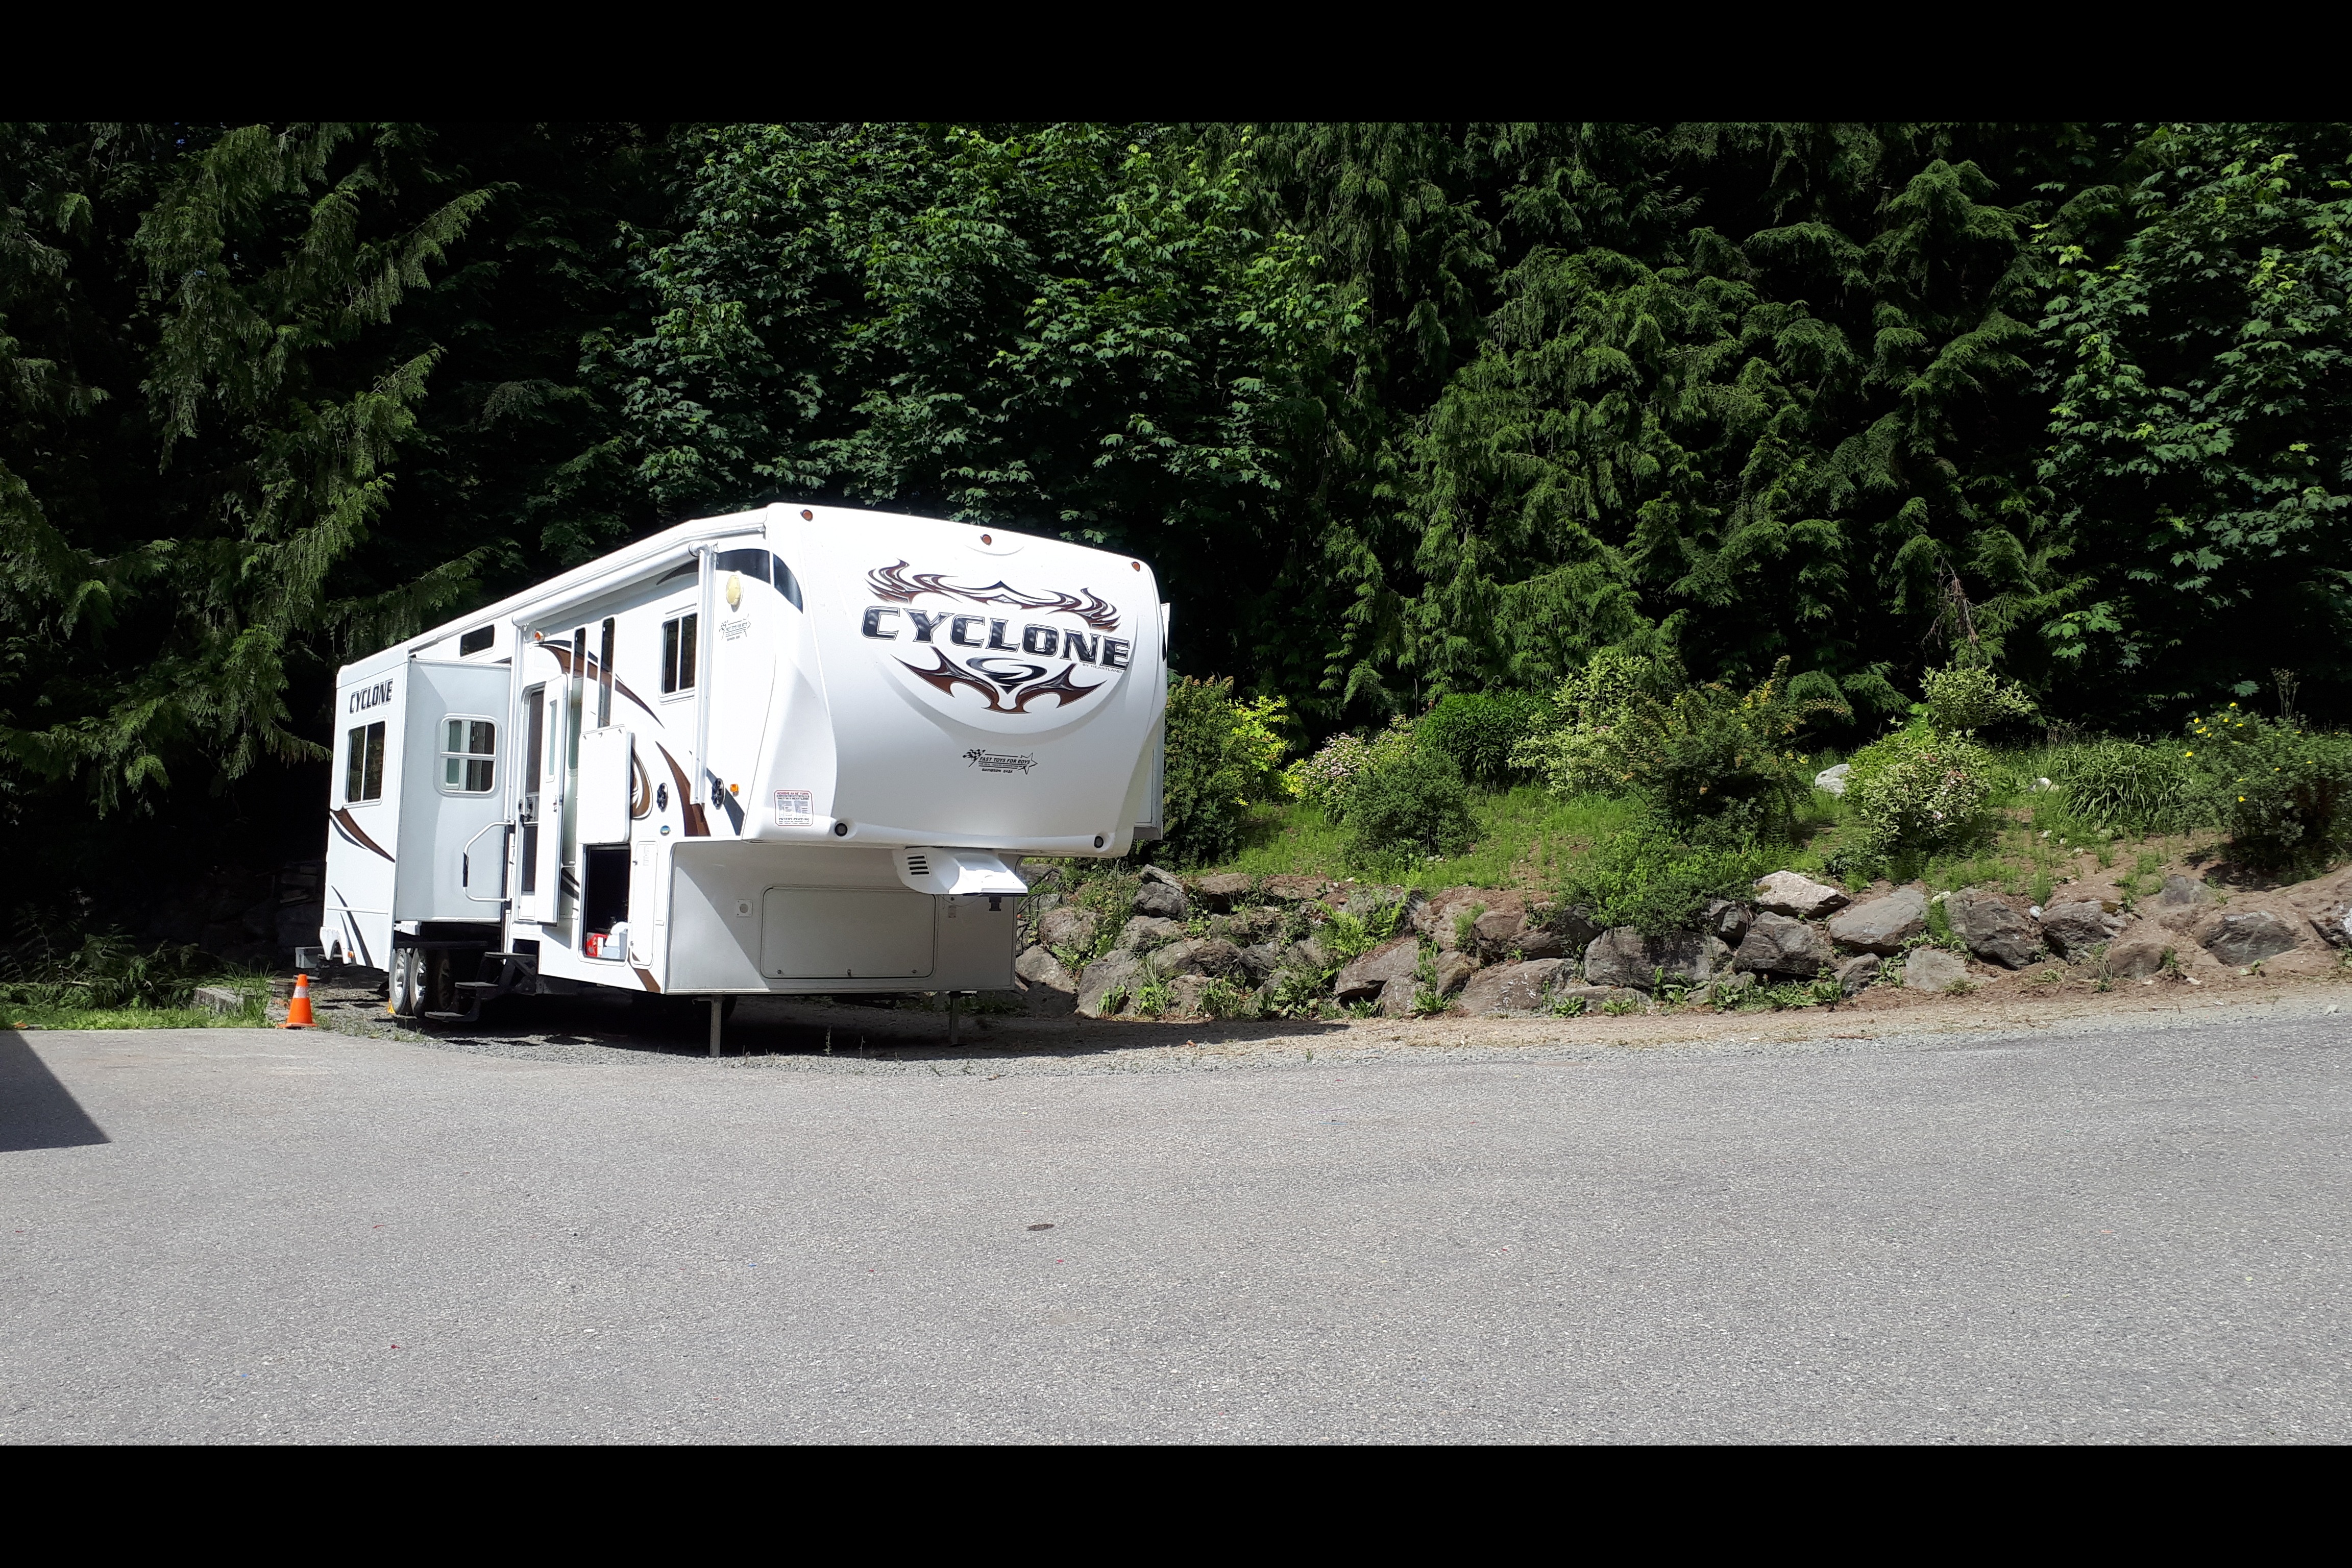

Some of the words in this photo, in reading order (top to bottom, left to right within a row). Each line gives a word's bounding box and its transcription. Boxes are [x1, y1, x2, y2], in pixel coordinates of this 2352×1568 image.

[861, 605, 1130, 671] CYCLONE
[1090, 665, 1122, 673] HEARTLAND
[350, 678, 393, 714] CYCLONE
